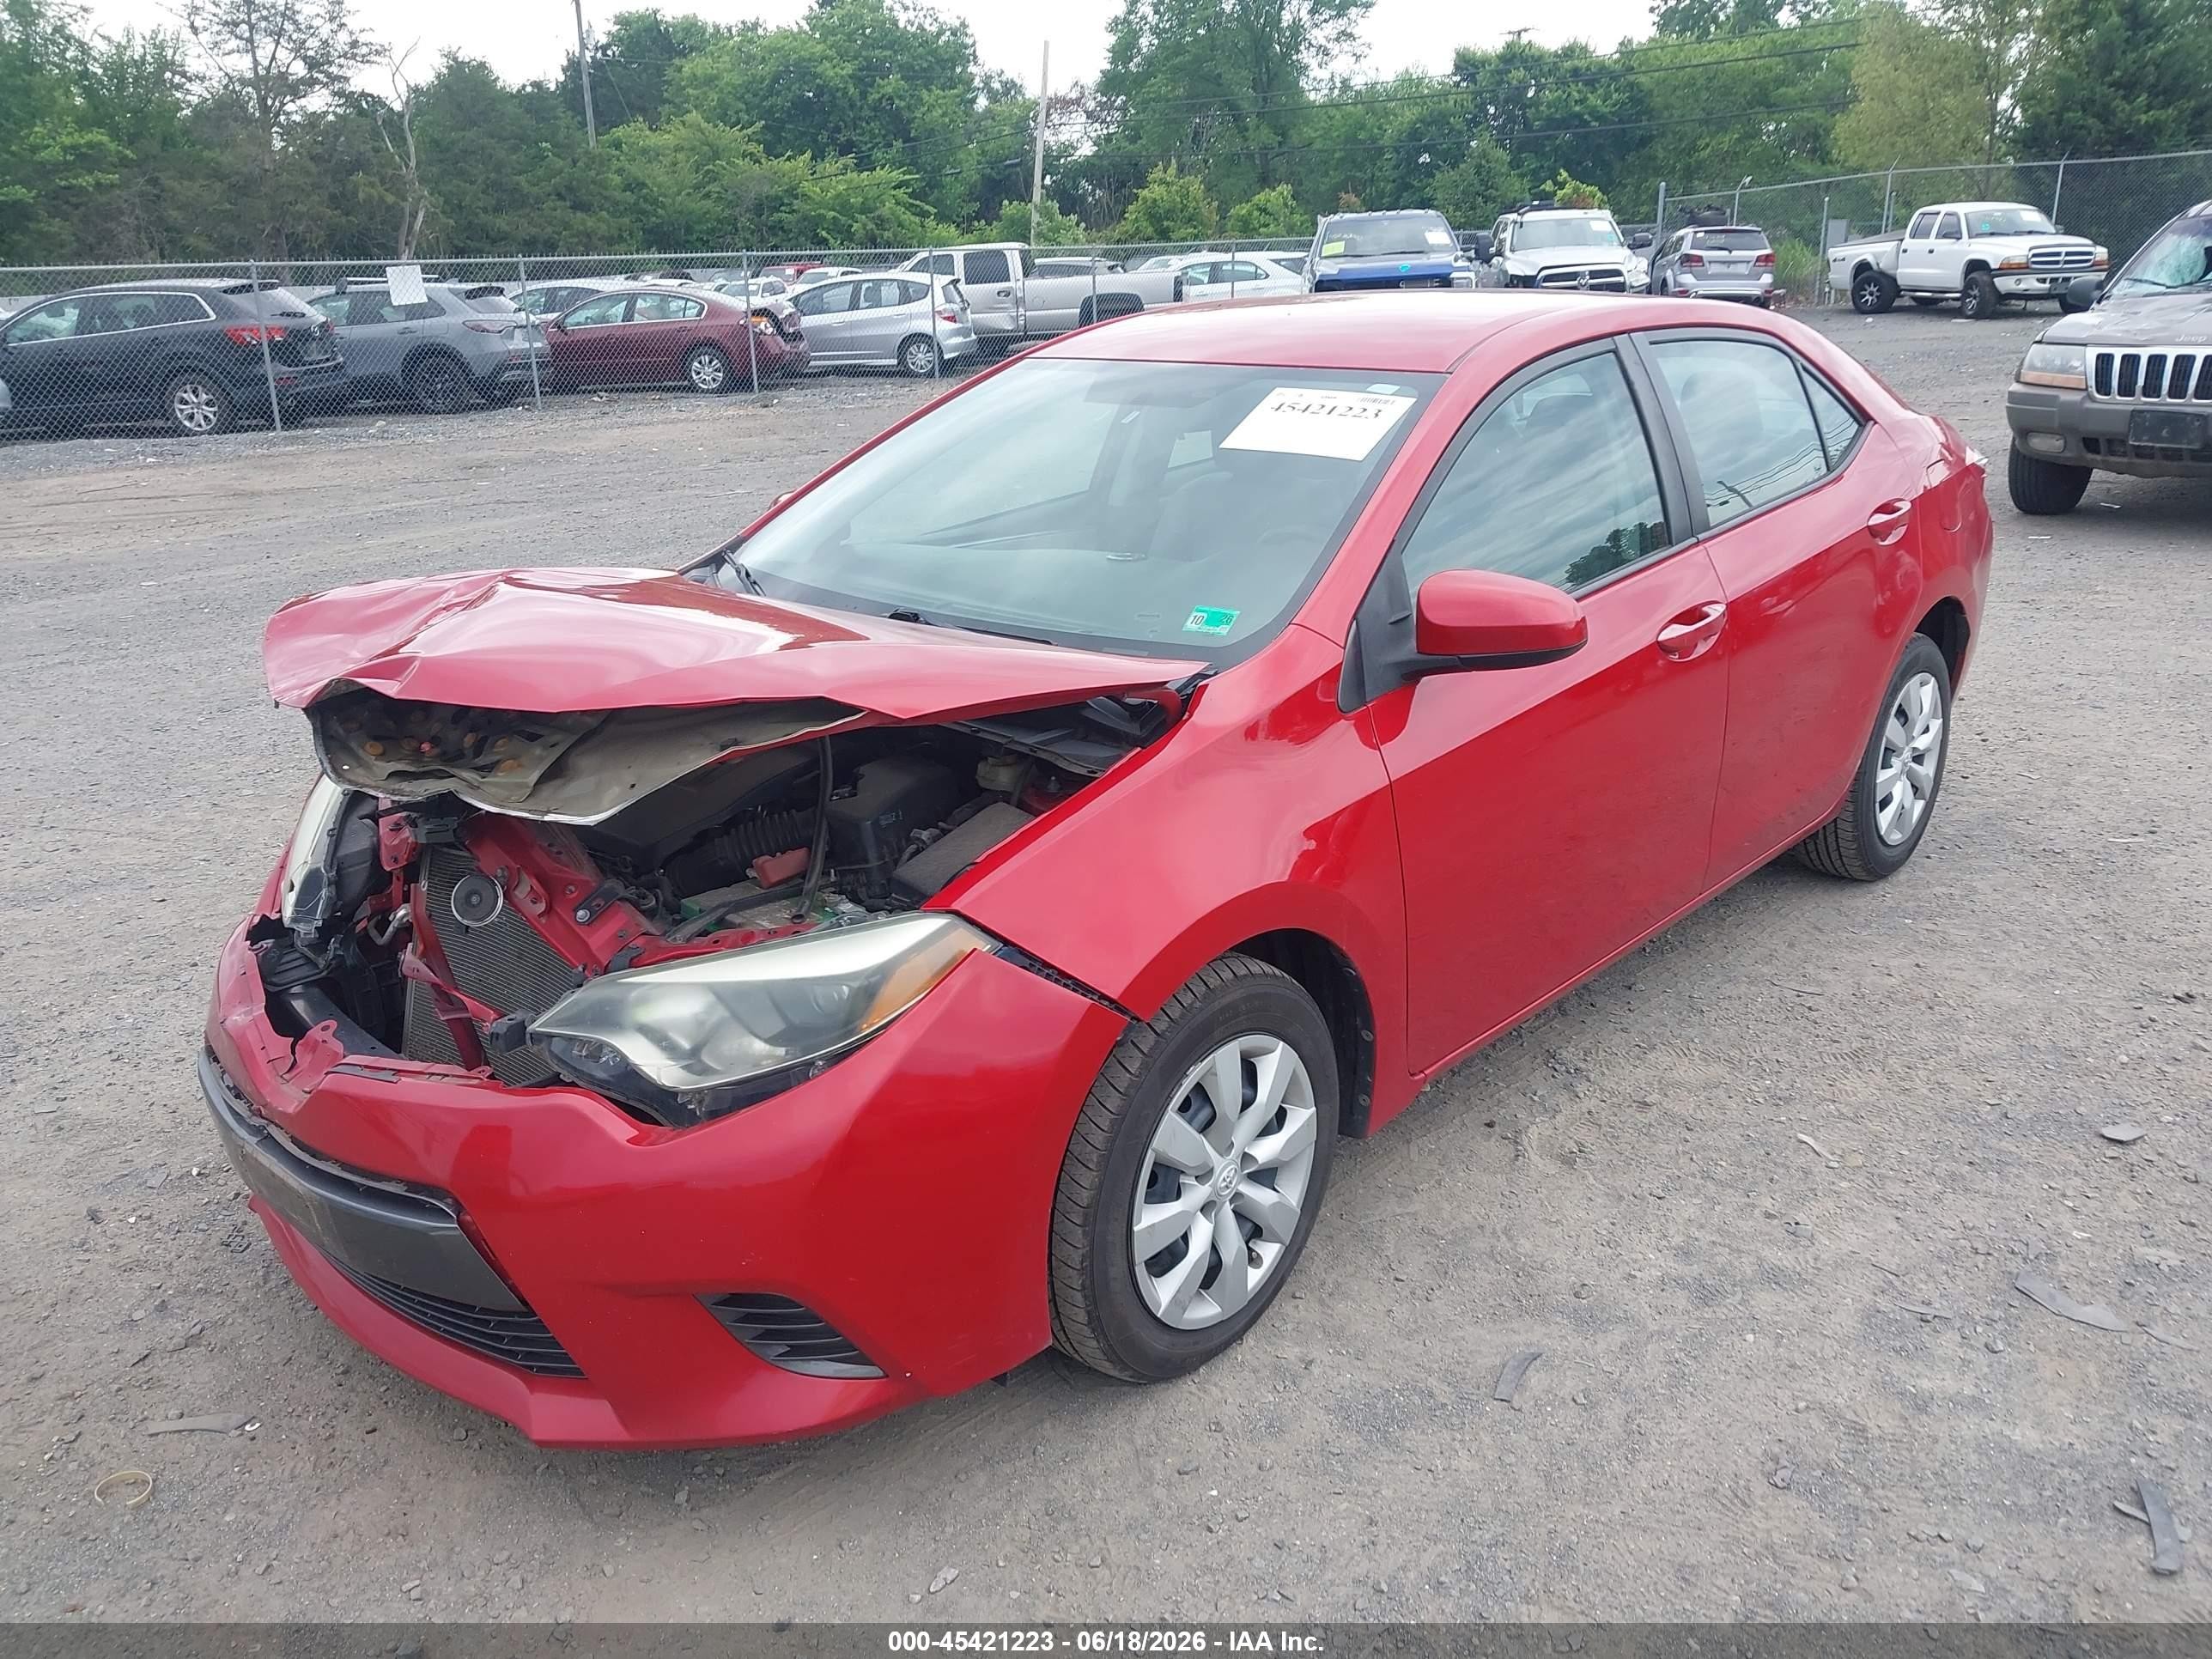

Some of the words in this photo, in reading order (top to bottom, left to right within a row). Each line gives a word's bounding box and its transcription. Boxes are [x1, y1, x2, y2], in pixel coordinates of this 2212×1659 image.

[2175, 334, 2207, 343] Jeep
[1270, 401, 1384, 419] 45421223
[1190, 615, 1205, 626] 10
[1221, 613, 1235, 625] 26
